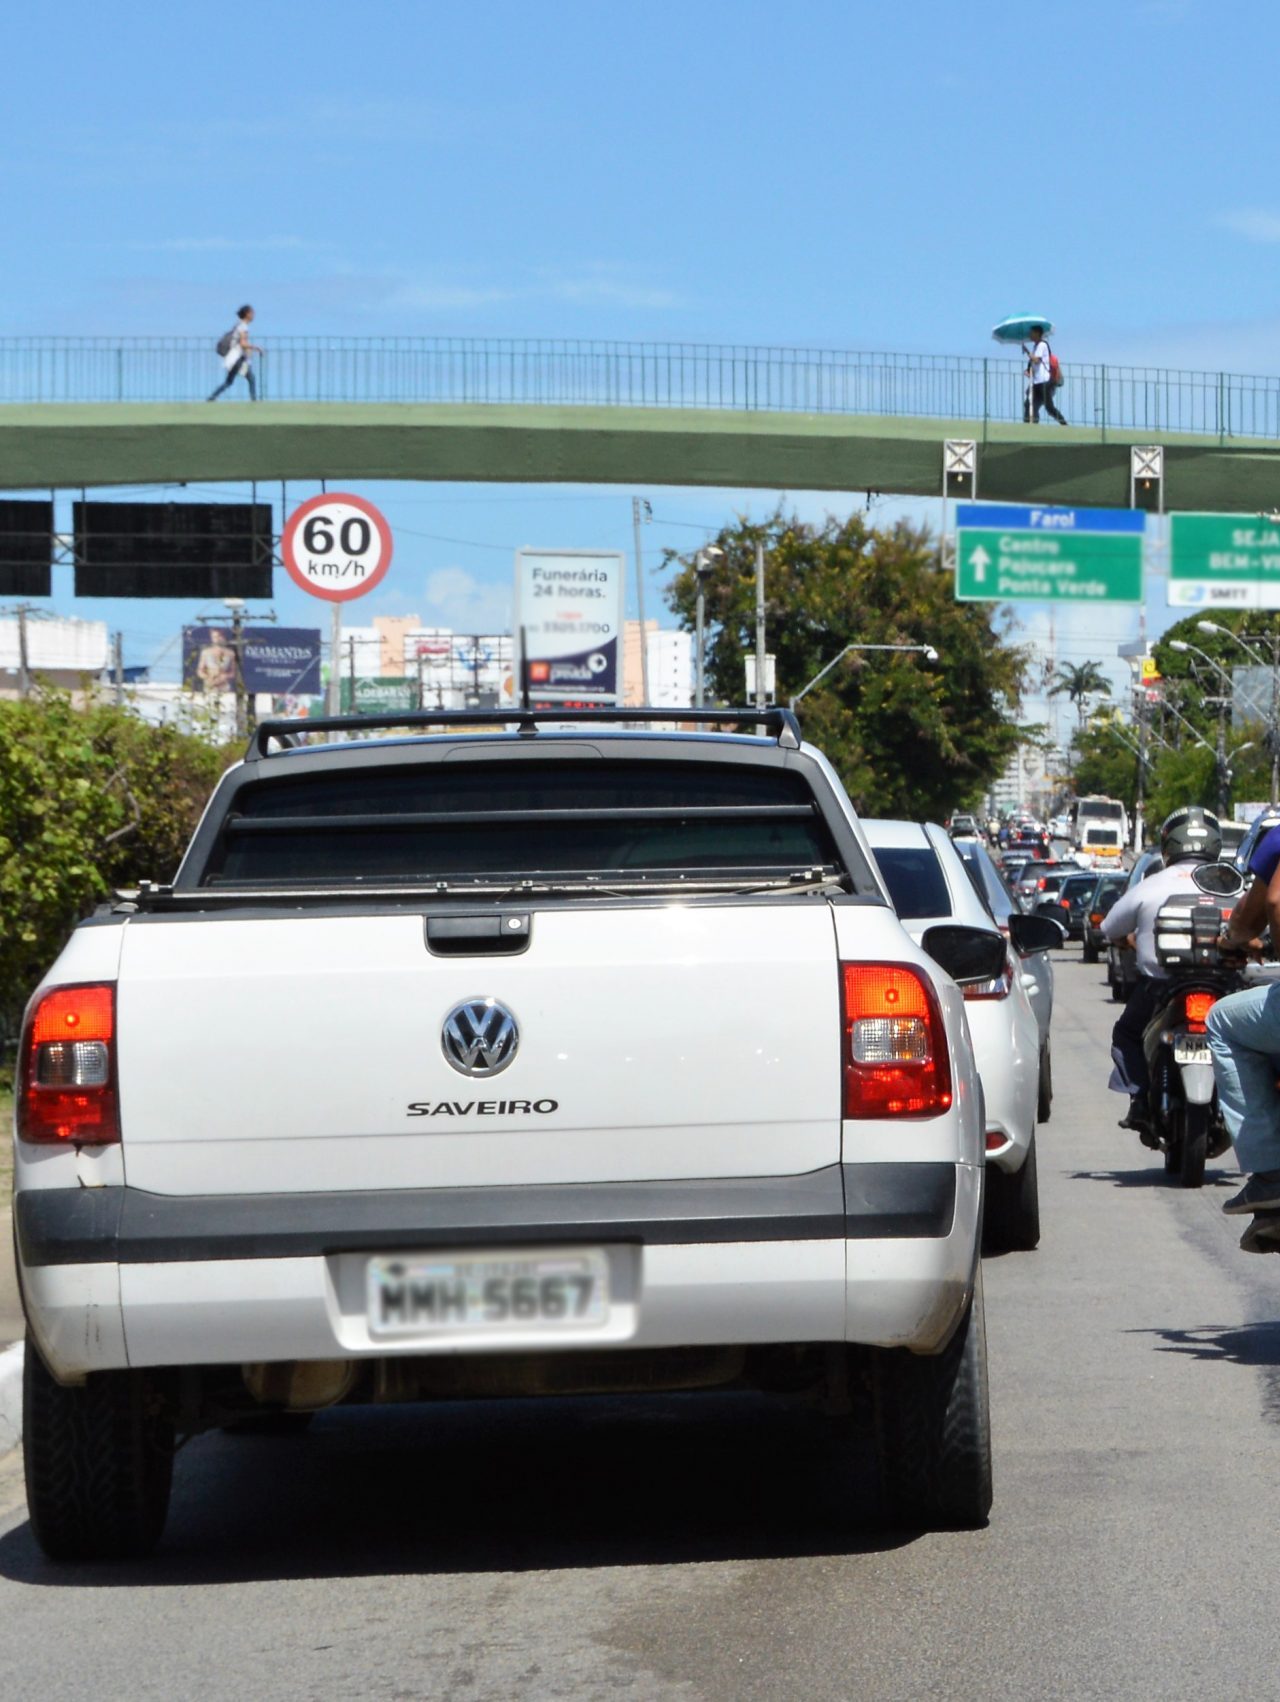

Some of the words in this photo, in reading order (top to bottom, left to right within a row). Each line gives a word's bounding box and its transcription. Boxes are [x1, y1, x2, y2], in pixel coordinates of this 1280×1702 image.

[1030, 510, 1075, 527] Farol
[304, 516, 370, 556] 60
[1232, 530, 1280, 547] SEJA
[999, 536, 1059, 554] Centro
[308, 560, 365, 577] km/h
[532, 567, 608, 583] Funerária
[533, 585, 553, 597] 24
[558, 585, 606, 598] horas.
[999, 577, 1052, 594] Ponta
[1057, 581, 1107, 597] Verde
[406, 1098, 559, 1116] SAVEIRO
[483, 1275, 596, 1322] 5667
